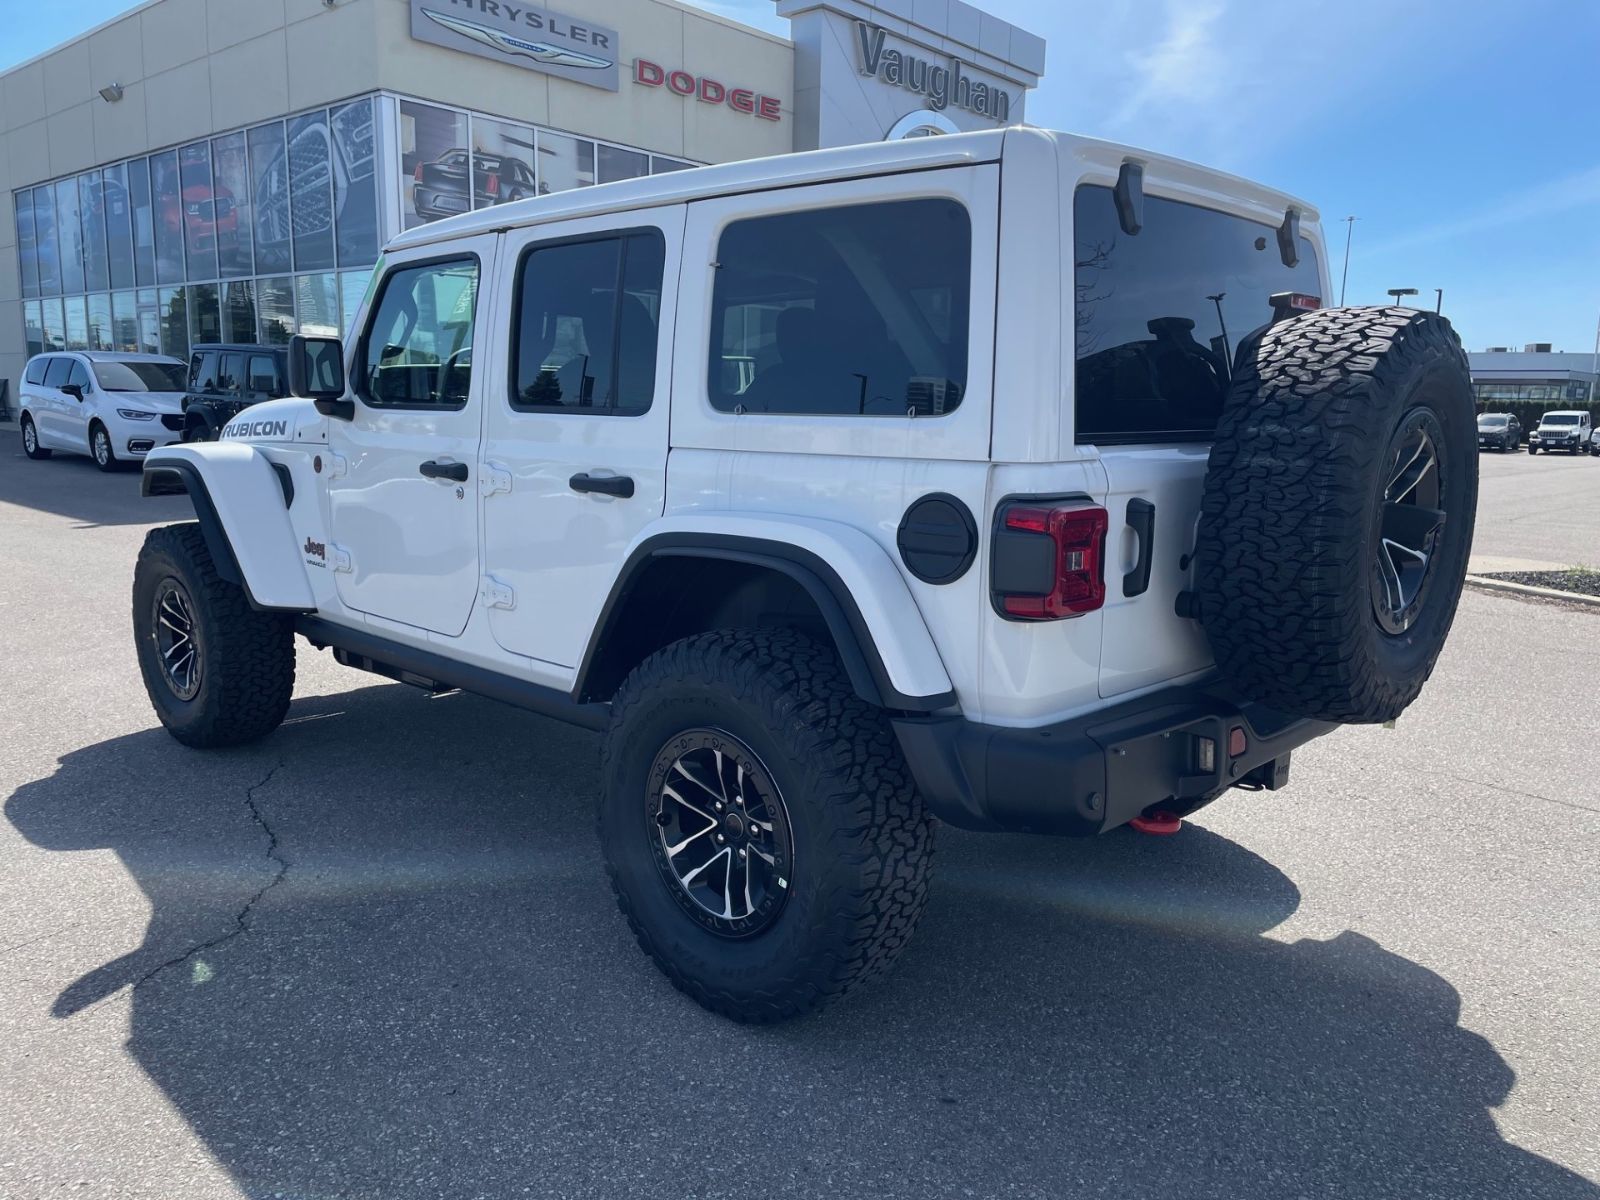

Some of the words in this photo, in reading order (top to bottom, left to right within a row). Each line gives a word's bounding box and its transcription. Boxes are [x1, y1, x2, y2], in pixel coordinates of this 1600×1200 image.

[633, 57, 781, 121] DODGE
[855, 20, 1010, 121] Vaughan
[222, 420, 287, 438] RUBICON
